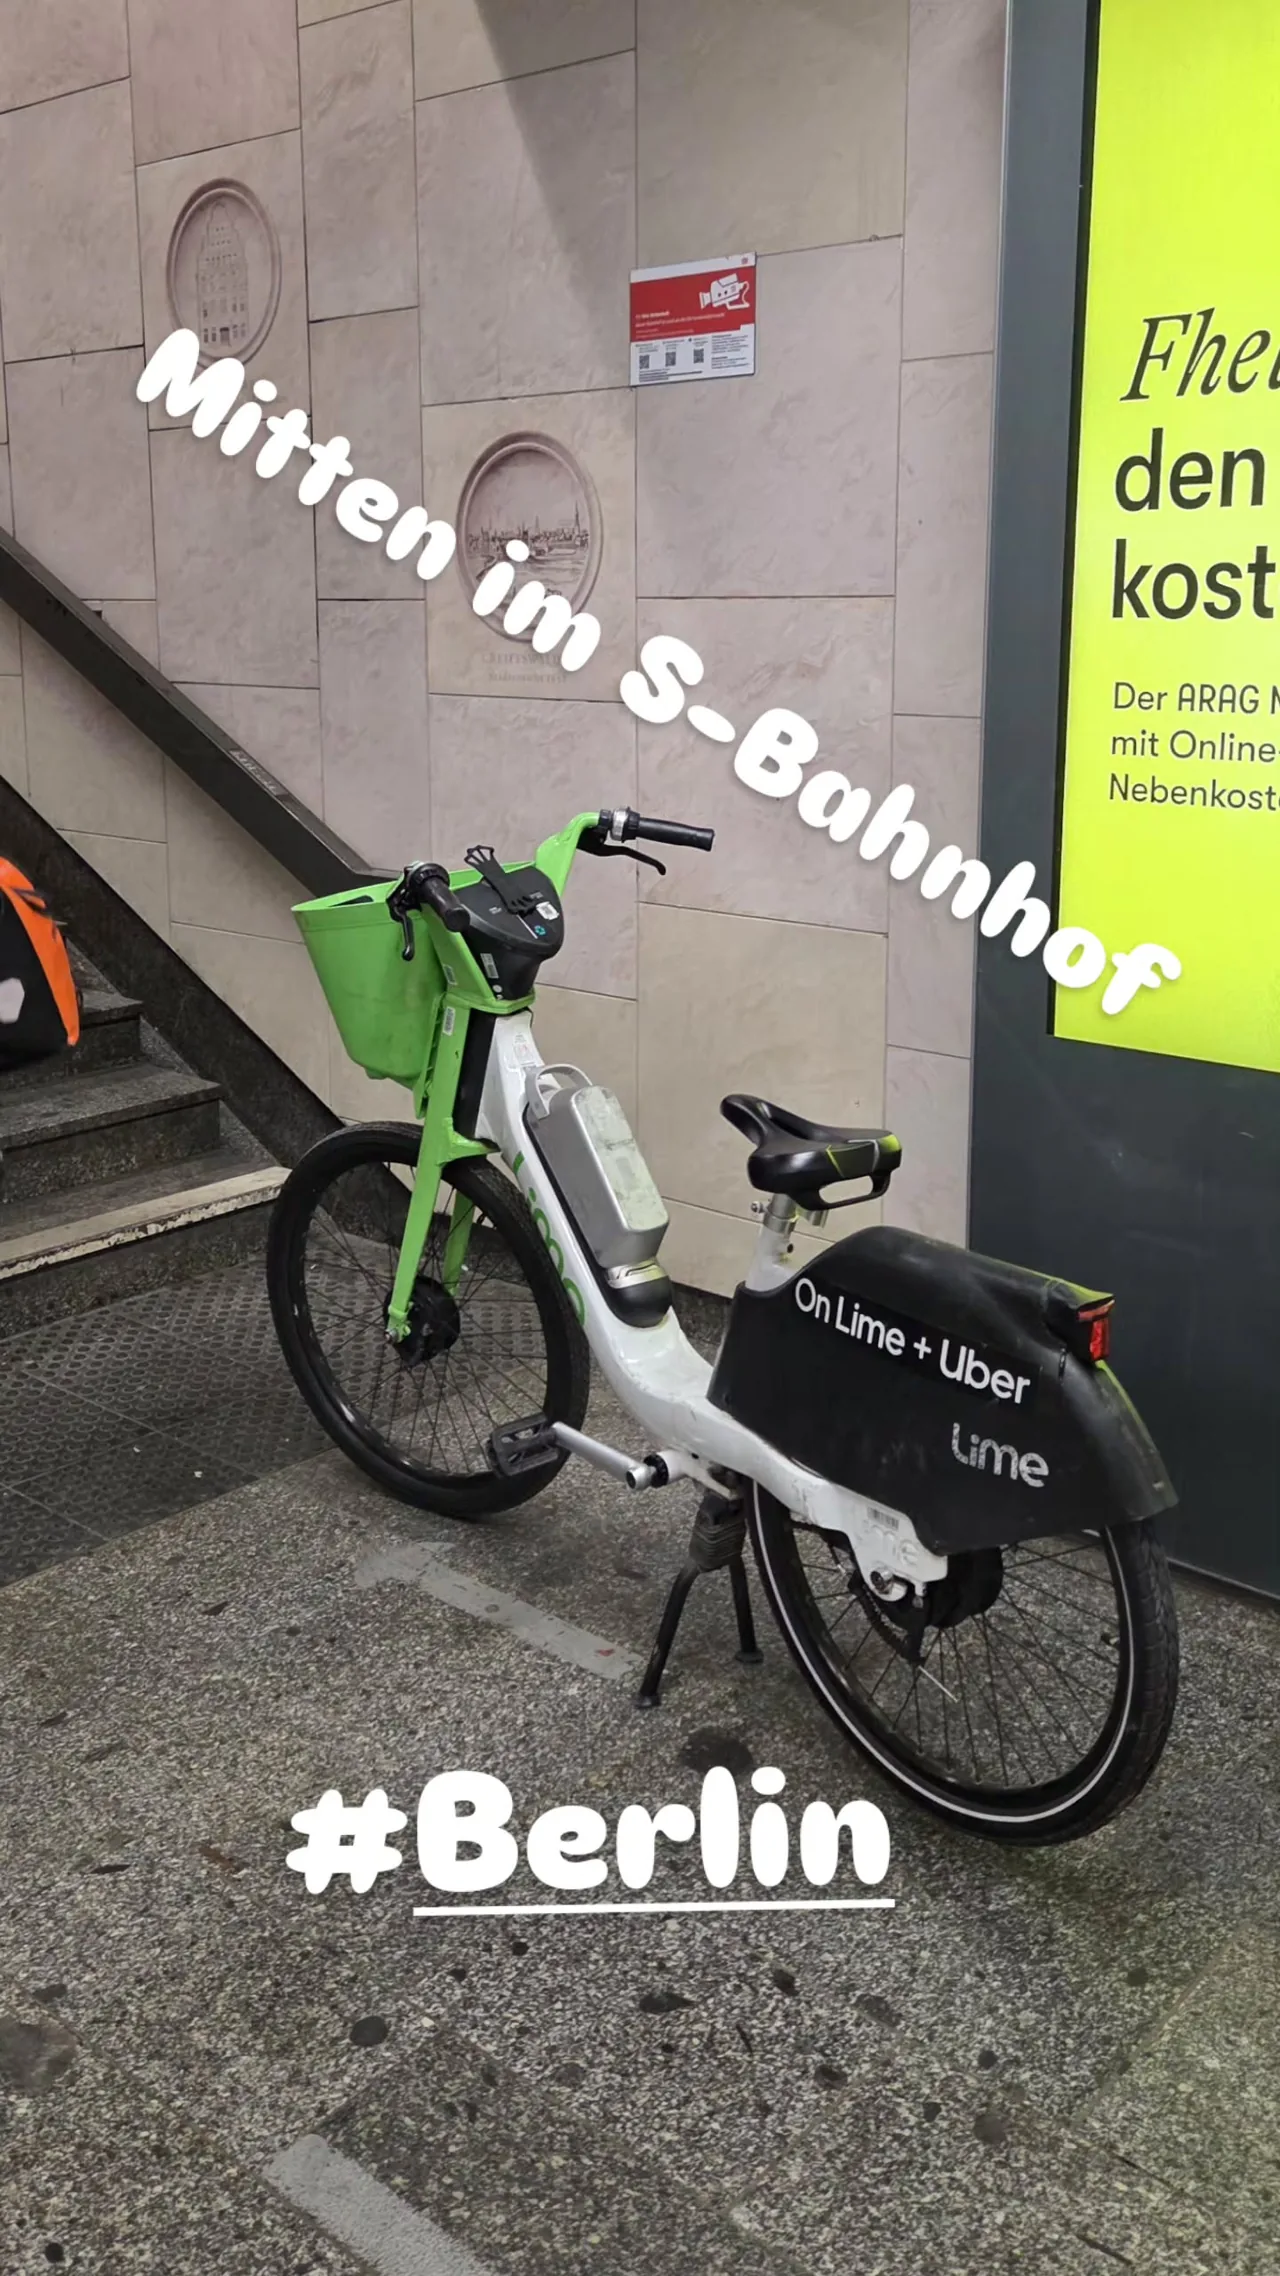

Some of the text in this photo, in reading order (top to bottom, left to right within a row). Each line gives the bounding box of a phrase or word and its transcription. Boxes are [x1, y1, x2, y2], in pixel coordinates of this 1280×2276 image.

[1115, 427, 1265, 512] den
[1112, 538, 1277, 620] kost
[1114, 681, 1168, 711] Der
[1178, 683, 1259, 714] ARAG
[1111, 729, 1160, 758] mit
[1109, 773, 1280, 811] Nebenkost
[795, 1277, 1031, 1404] On Lime + Uber
[951, 1422, 1050, 1488] Lime
